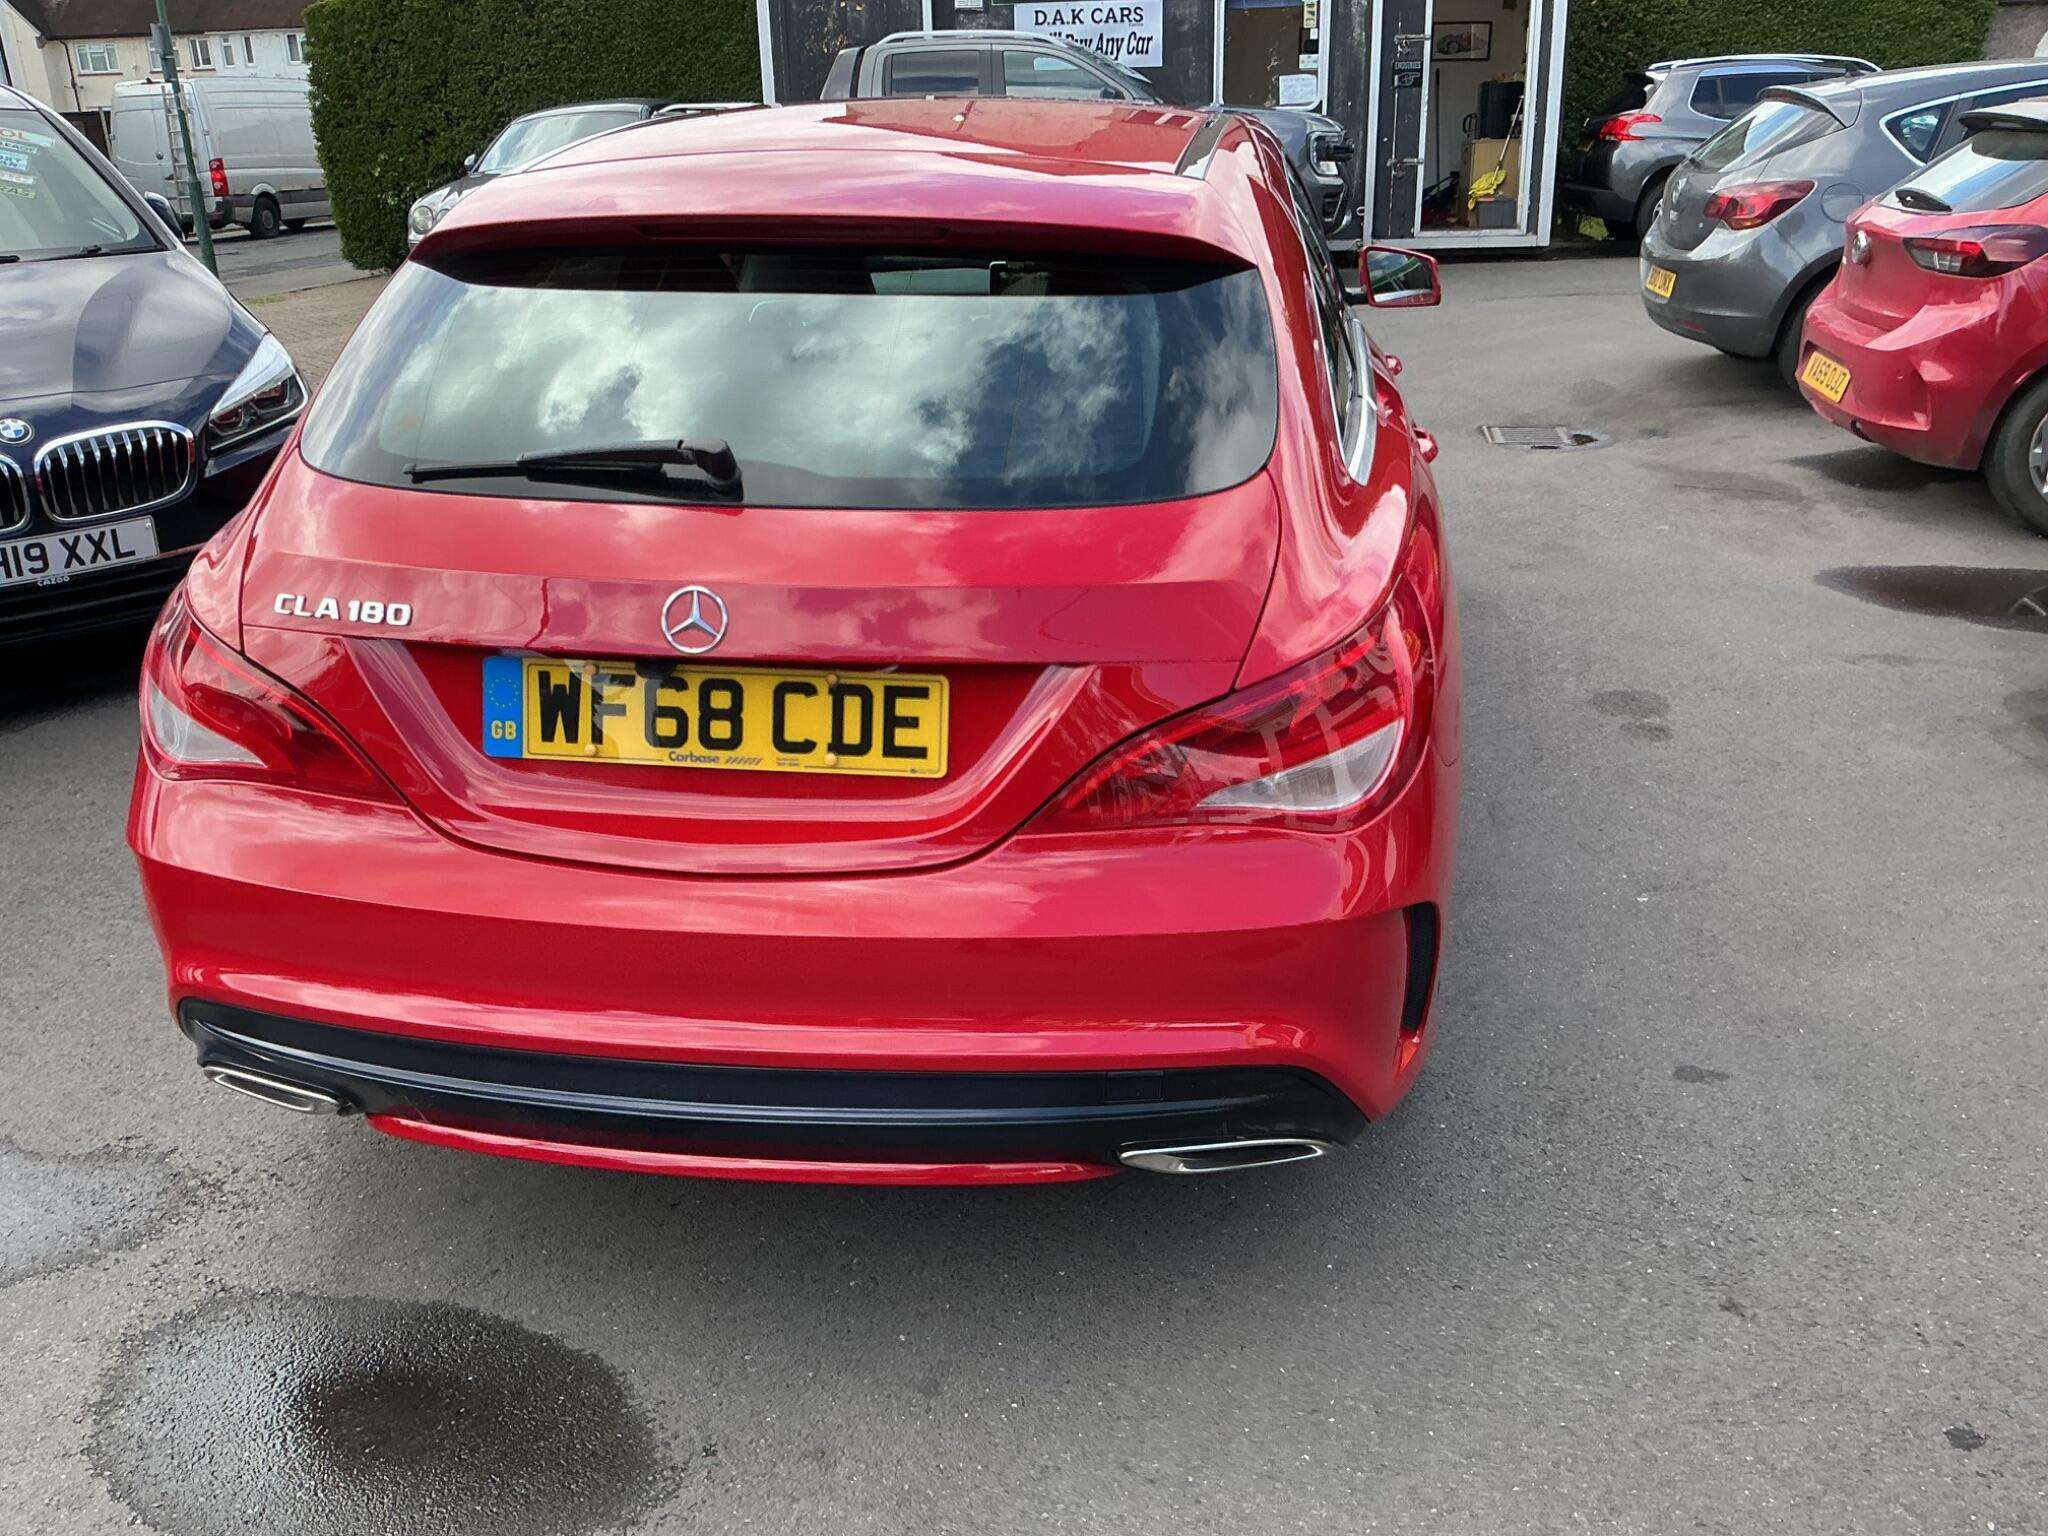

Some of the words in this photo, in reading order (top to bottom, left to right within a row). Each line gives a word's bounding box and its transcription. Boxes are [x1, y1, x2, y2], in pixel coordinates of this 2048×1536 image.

[1034, 8, 1085, 26] D.A.K
[1091, 6, 1144, 24] CARS
[1095, 32, 1125, 61] Any
[1127, 31, 1153, 56] Car
[58, 528, 136, 570] XXL
[273, 592, 341, 621] CLA
[347, 599, 413, 627] 180
[538, 669, 743, 752] WF68
[772, 681, 930, 760] CDE
[491, 719, 517, 741] GB
[668, 750, 720, 765] Carbase
